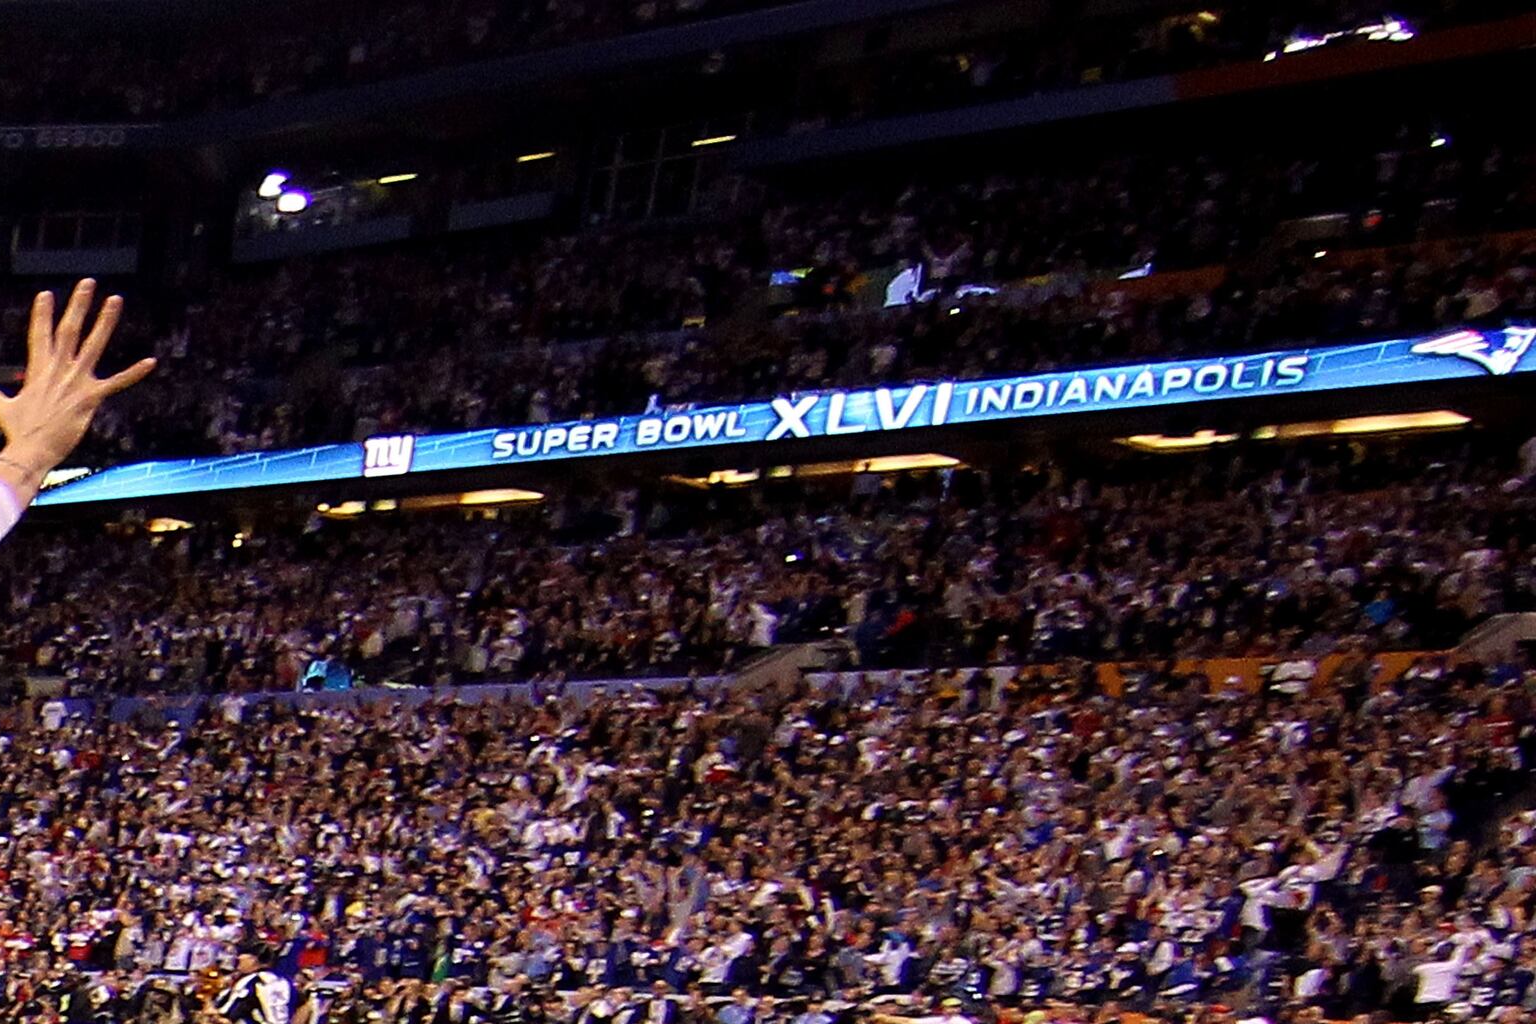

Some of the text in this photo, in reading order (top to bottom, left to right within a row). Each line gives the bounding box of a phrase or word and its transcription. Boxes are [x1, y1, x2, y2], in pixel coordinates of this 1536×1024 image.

[492, 356, 1308, 459] SUPER BOWL XLVI INDIANAPOLIS
